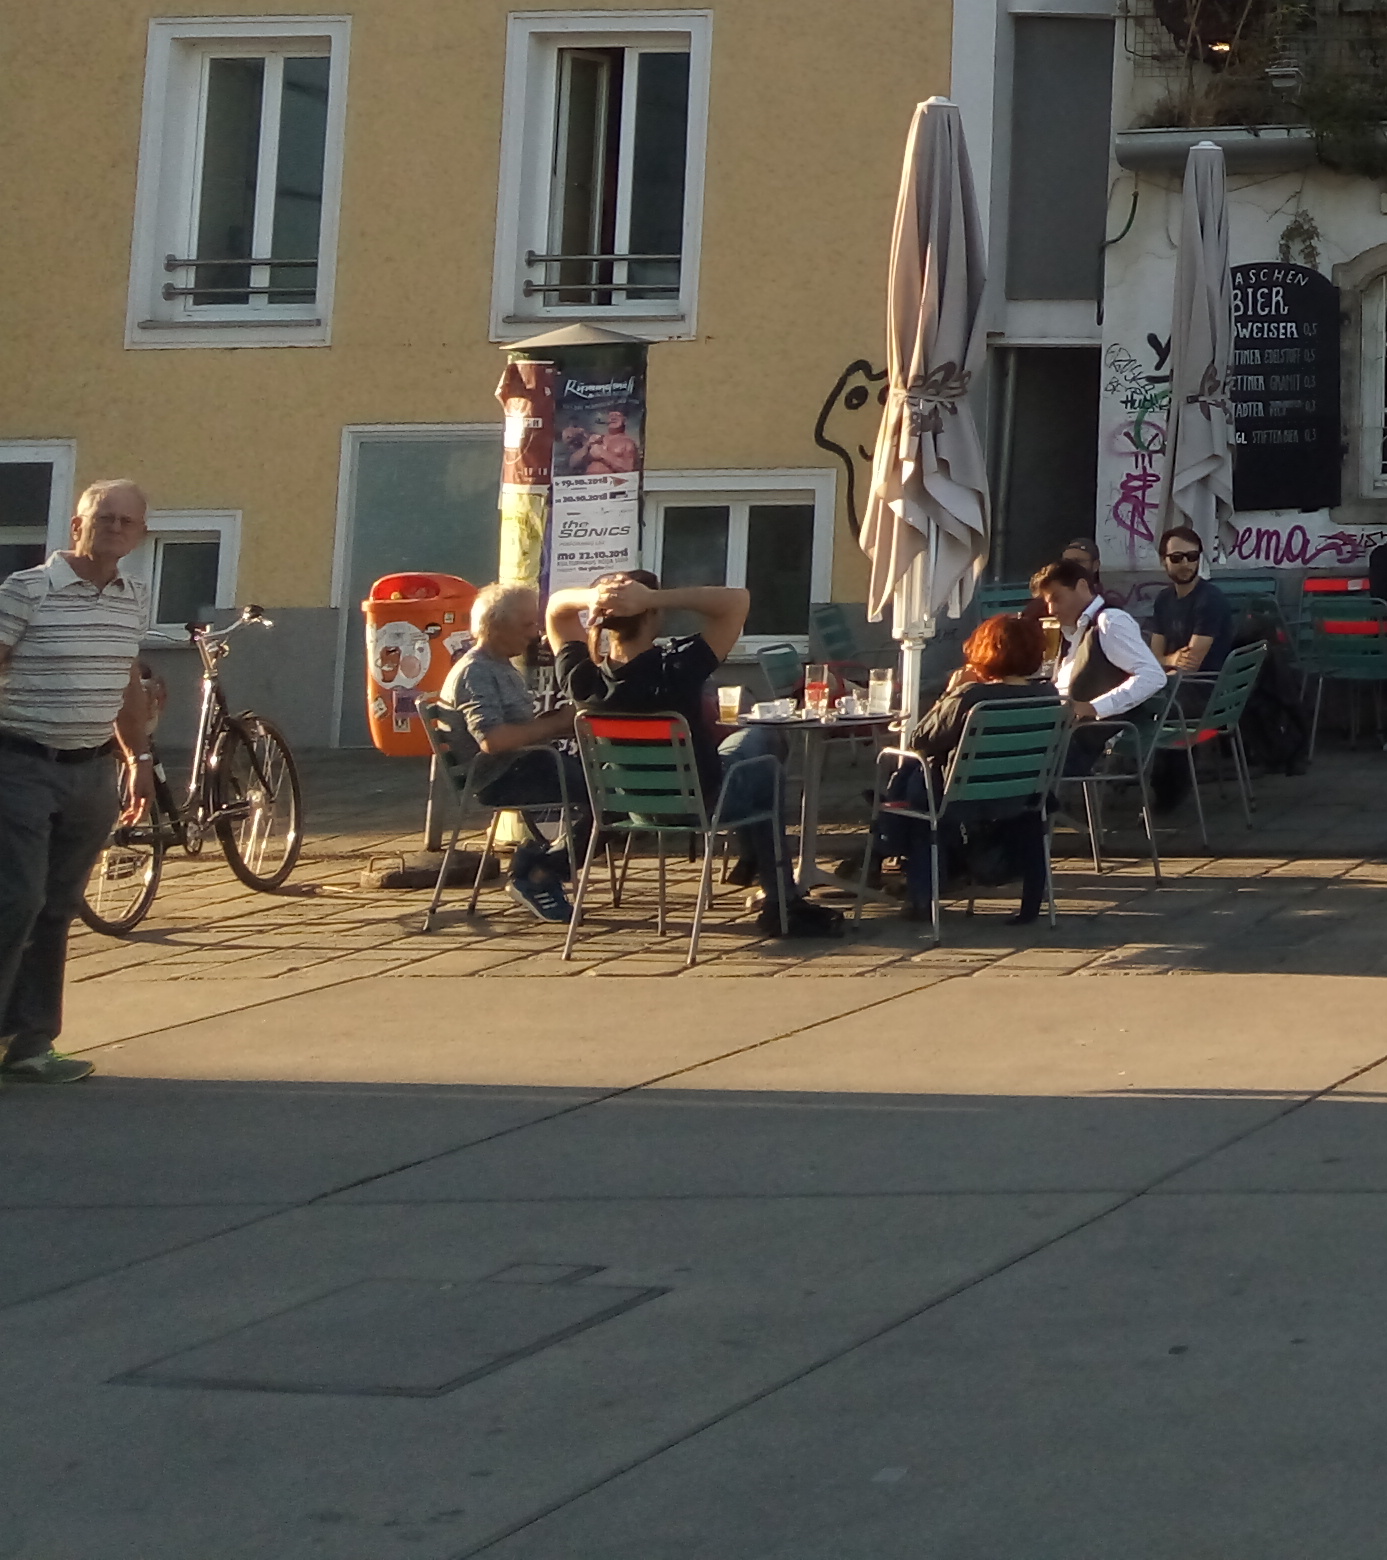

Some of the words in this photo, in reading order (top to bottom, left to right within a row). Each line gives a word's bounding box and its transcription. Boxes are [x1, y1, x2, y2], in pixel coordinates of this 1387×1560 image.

[1235, 269, 1309, 286] ASCHEN
[1232, 287, 1289, 315] BIER
[1235, 322, 1299, 339] WEISER
[562, 520, 589, 529] the
[558, 526, 631, 538] SONICS
[557, 552, 576, 560] mo
